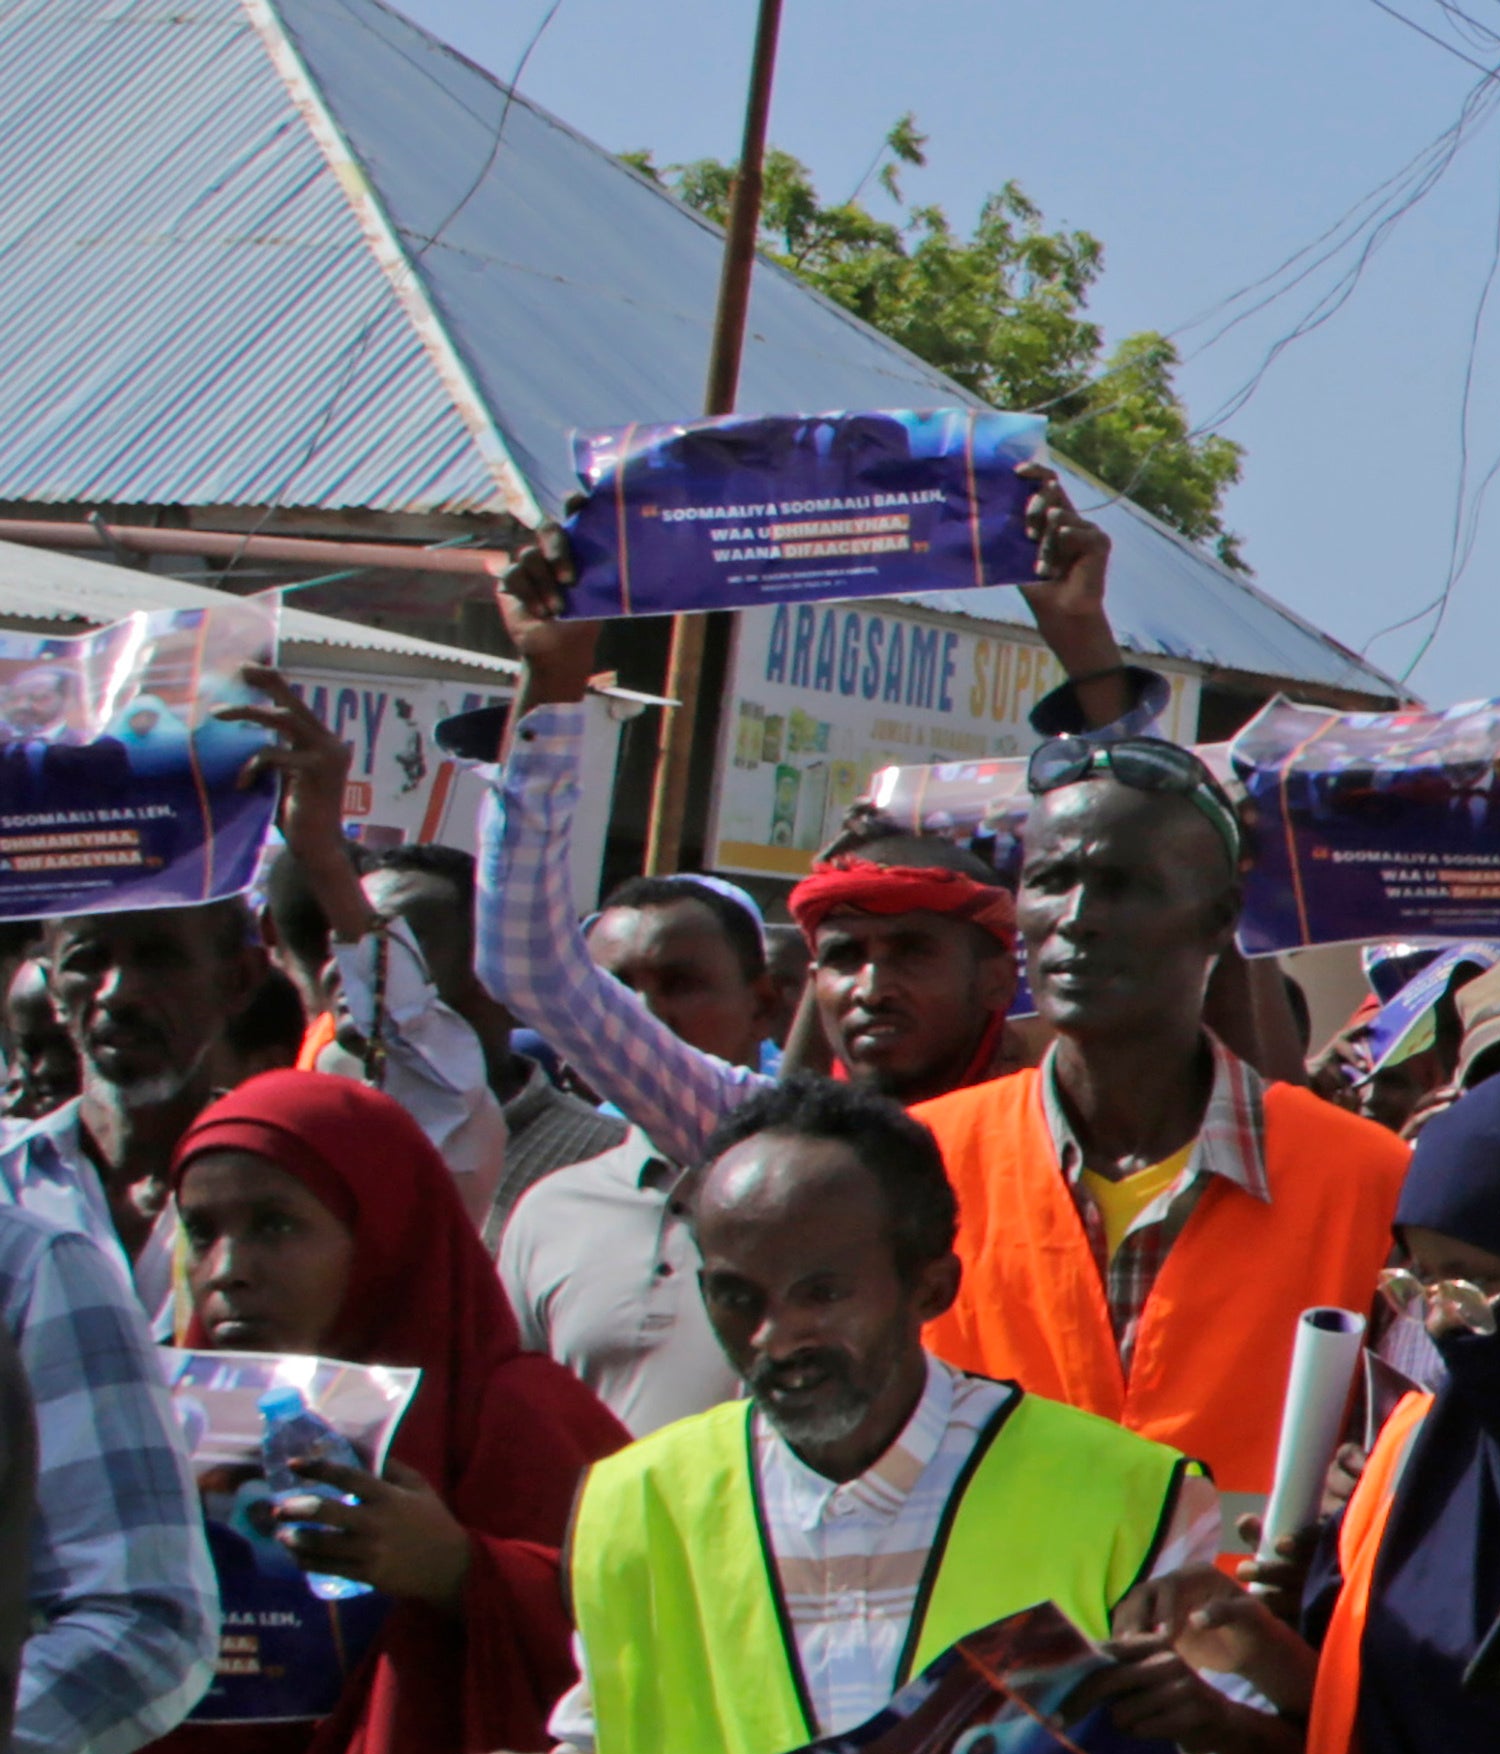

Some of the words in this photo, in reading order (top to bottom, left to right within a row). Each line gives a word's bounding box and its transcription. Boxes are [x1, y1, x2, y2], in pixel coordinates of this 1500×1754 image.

[661, 503, 778, 523] SOOMAALIYA
[780, 496, 871, 515] SOOMAALI
[873, 492, 910, 508] BAA
[711, 527, 756, 541] WAA
[713, 545, 782, 562] WAANA
[766, 603, 959, 712] ARAGSAME
